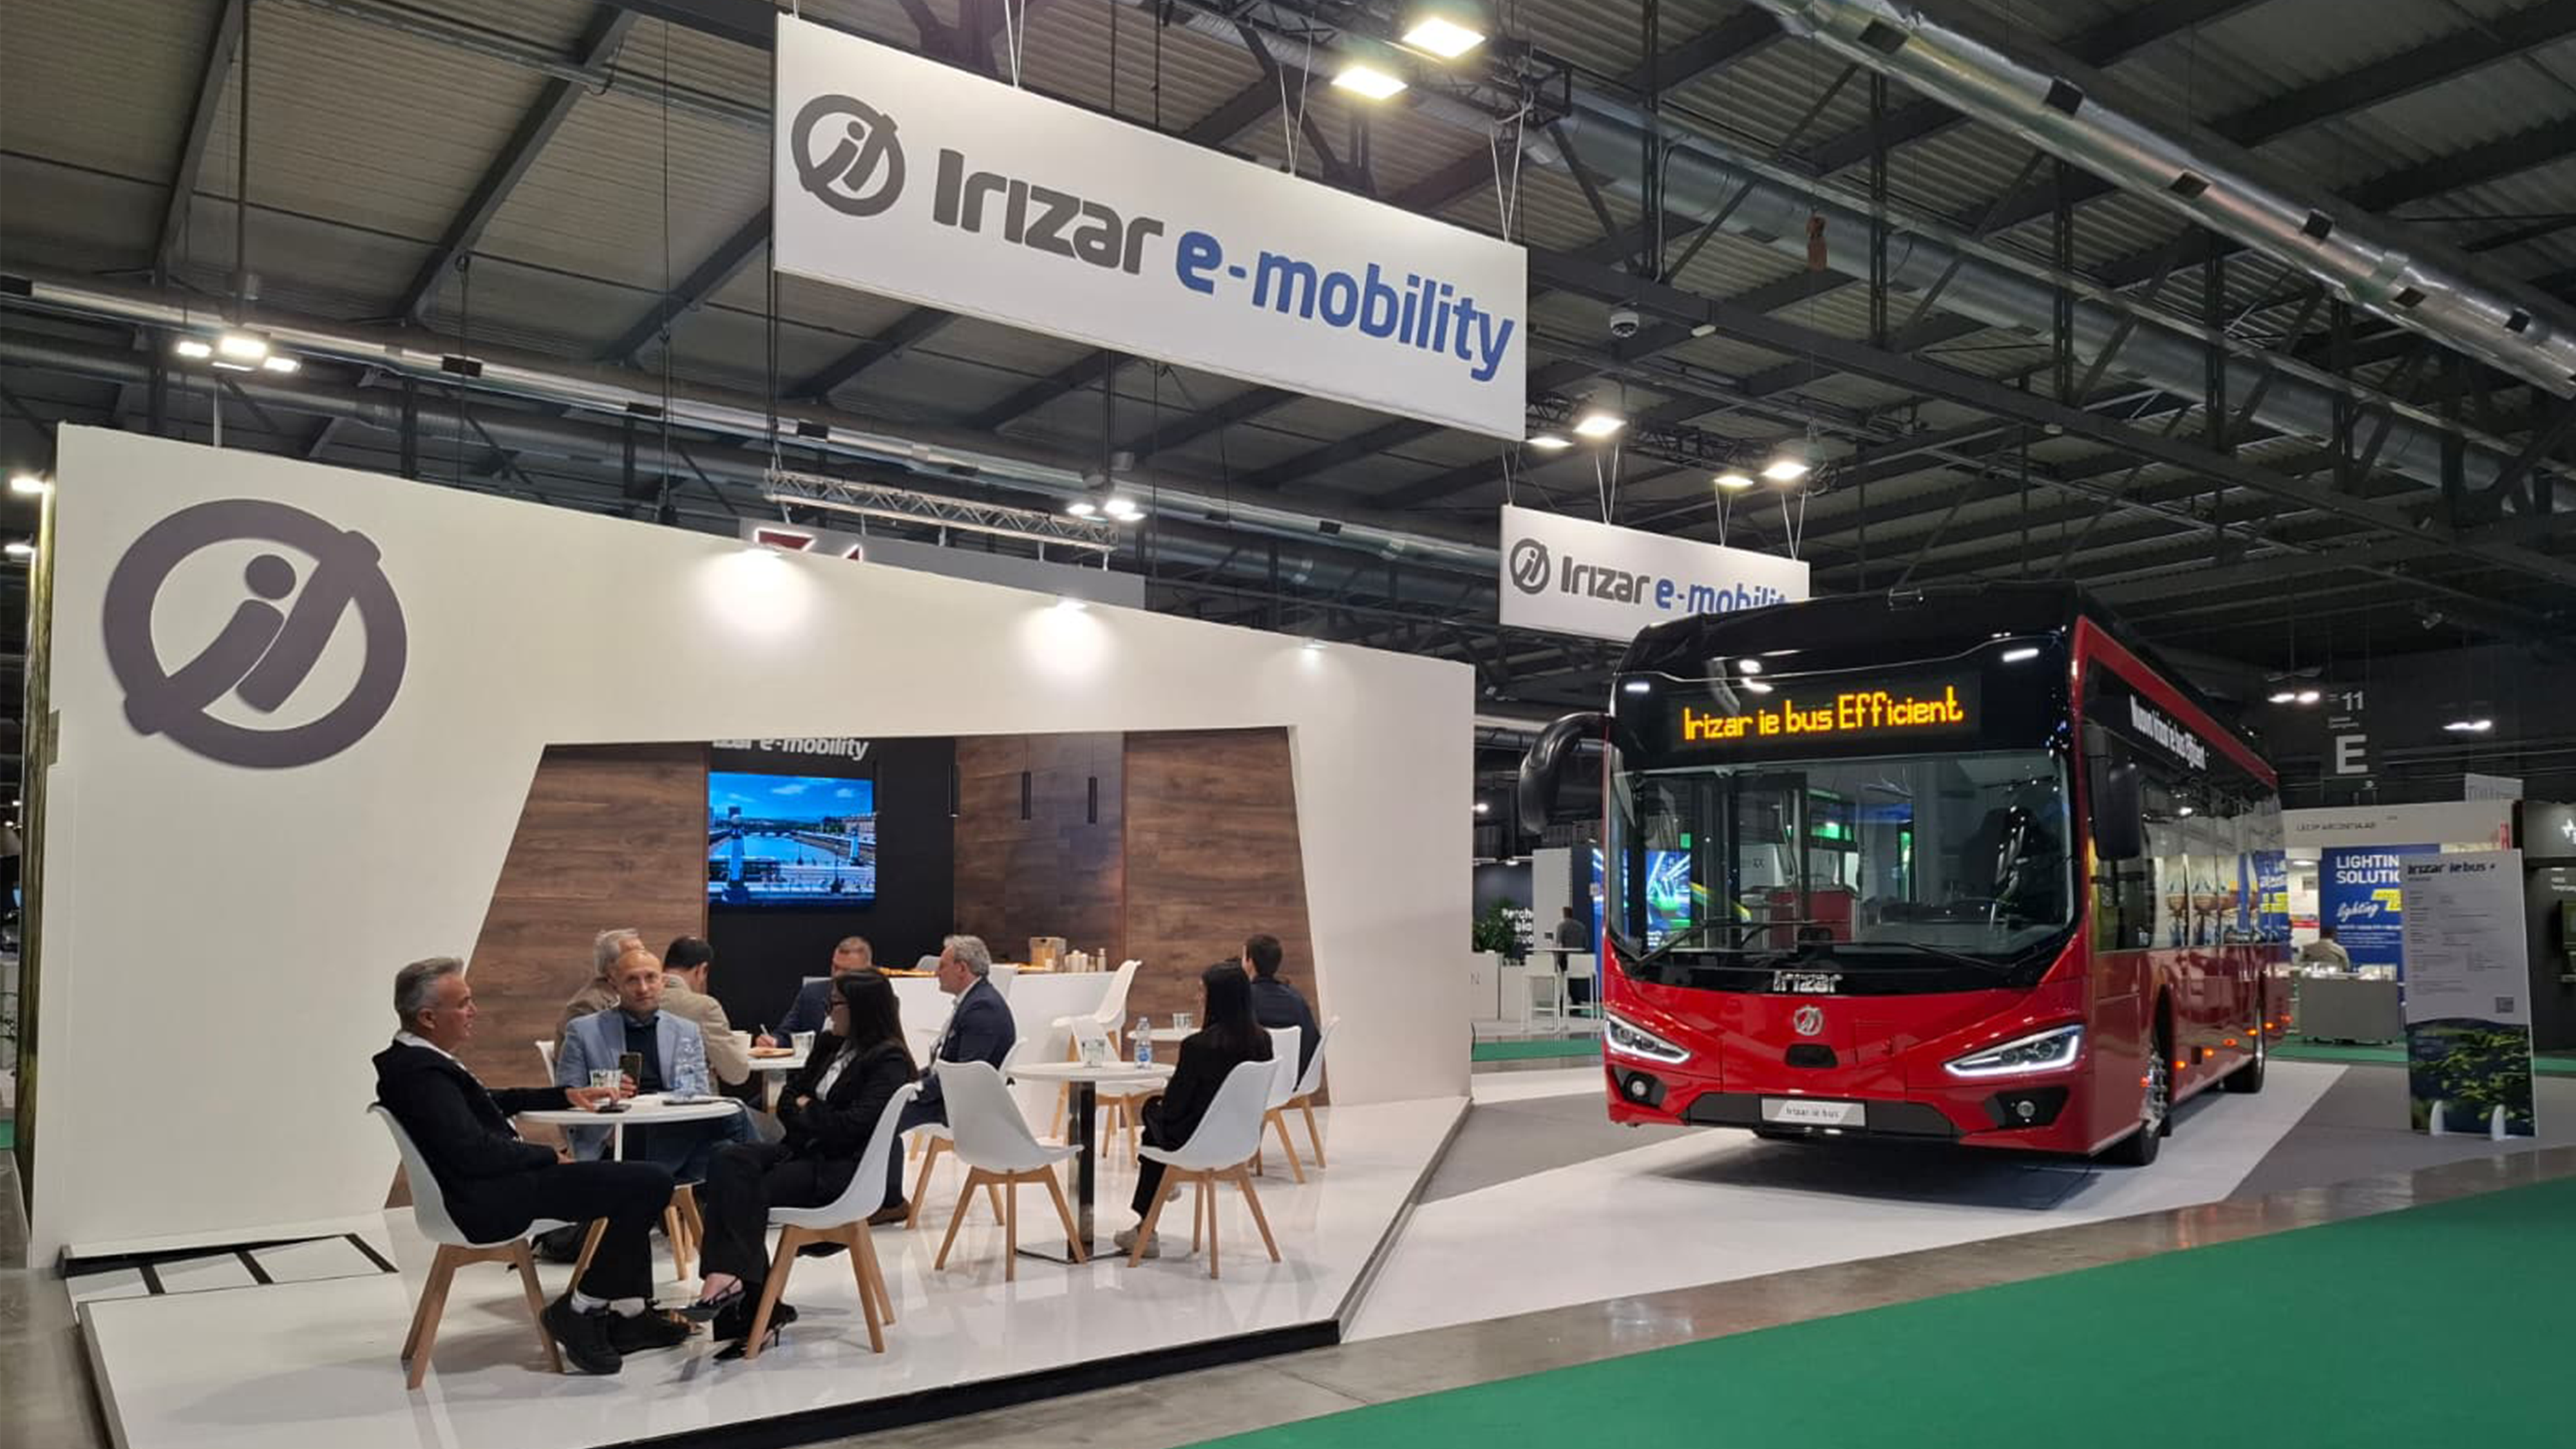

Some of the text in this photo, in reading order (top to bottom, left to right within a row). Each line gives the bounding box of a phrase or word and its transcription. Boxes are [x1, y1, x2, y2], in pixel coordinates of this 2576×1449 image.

[933, 148, 1514, 381] Irizar e-mobility
[1560, 556, 1650, 604] Irizar
[1684, 685, 1964, 740] Irizar ie bus Efficient
[2341, 690, 2363, 710] 11
[2336, 734, 2368, 774] E
